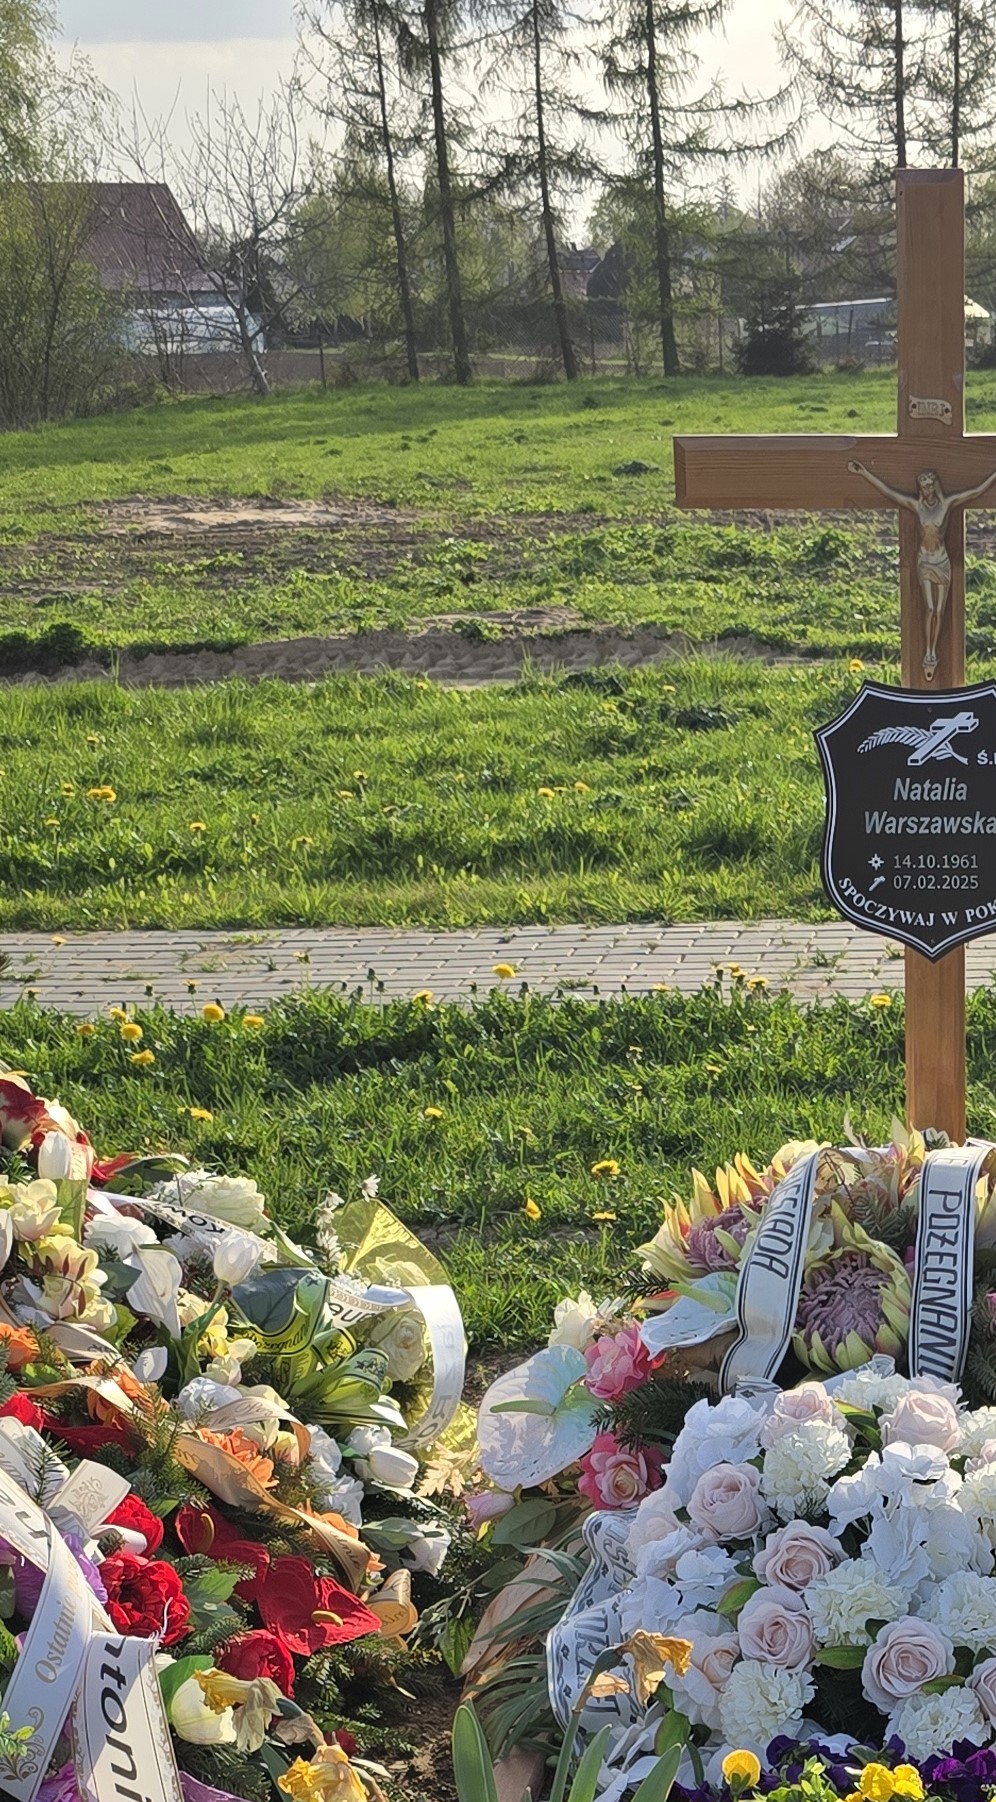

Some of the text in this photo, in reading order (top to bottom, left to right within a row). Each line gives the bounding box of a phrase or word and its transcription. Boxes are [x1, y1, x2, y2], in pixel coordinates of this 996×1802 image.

[893, 777, 968, 801] Natalia
[893, 854, 979, 869] 14.10.1961
[893, 875, 979, 890] 07.02.2025
[838, 877, 934, 927] SPOCZYWAJ
[941, 912, 958, 926] W
